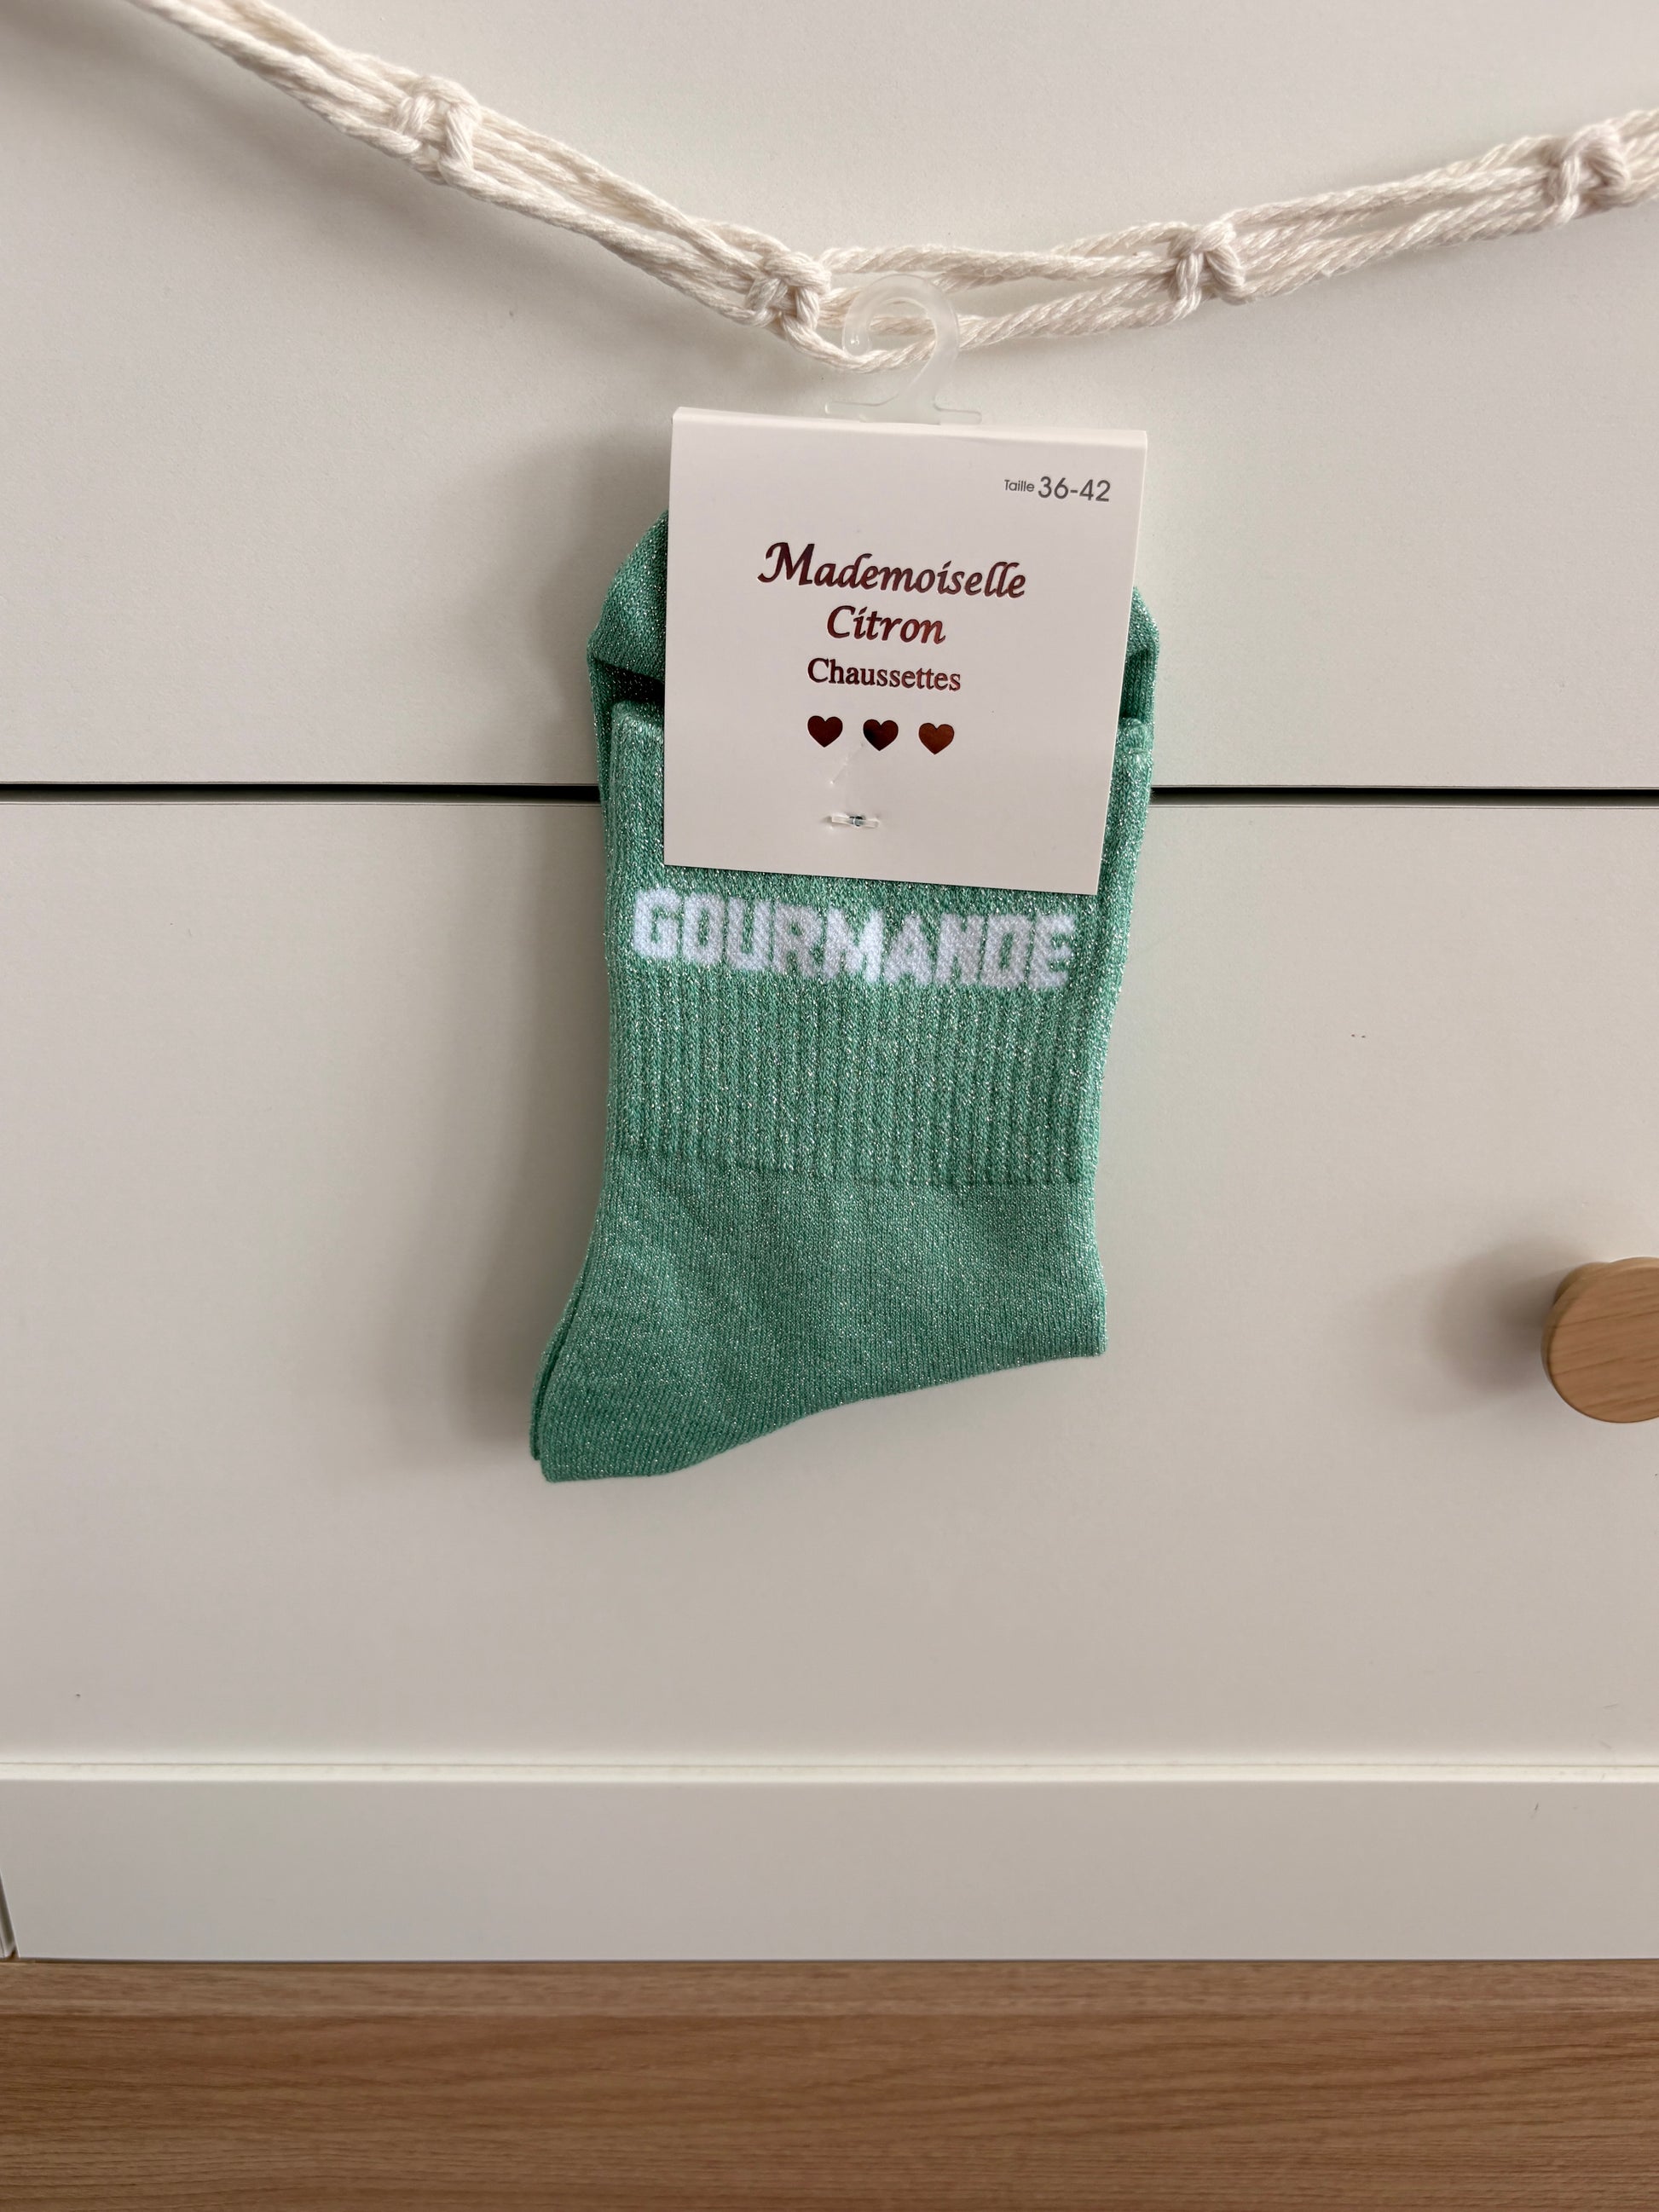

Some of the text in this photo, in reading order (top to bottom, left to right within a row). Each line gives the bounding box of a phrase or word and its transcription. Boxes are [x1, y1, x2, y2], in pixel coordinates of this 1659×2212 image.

[1003, 476, 1111, 502] Taille 36-42
[757, 542, 1026, 598] Mademoiselle
[826, 604, 946, 644] Citron
[807, 657, 962, 691] Chaussettes
[632, 885, 1075, 991] GOURMANDE
